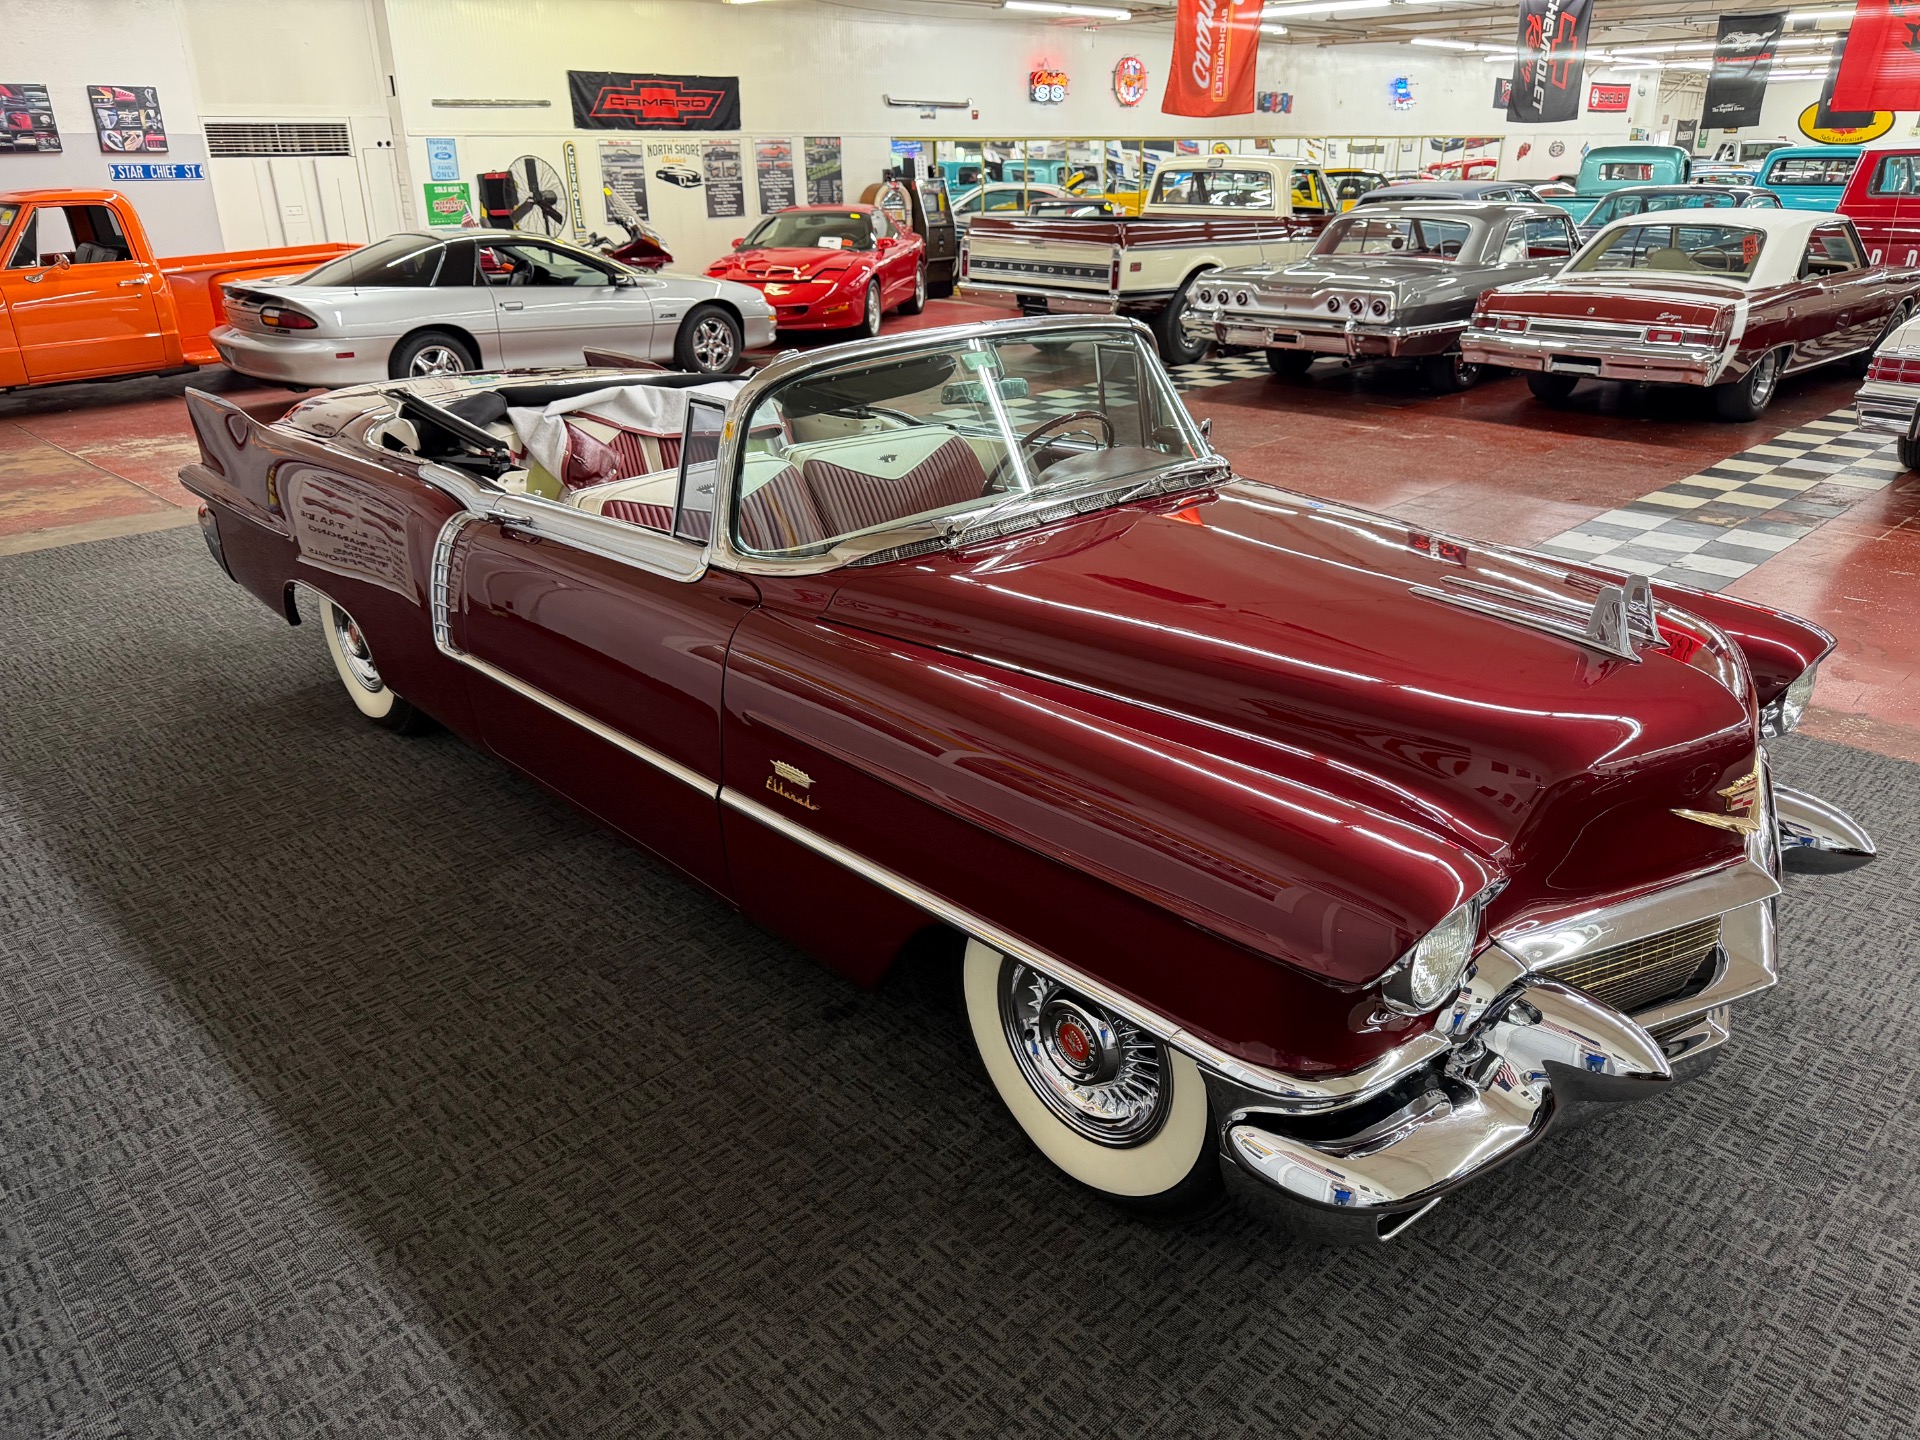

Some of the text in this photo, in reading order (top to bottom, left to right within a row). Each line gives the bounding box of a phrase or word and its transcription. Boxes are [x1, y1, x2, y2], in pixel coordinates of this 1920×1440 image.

[1192, 0, 1217, 89] maro
[1531, 0, 1560, 115] HEVROLET
[1215, 23, 1228, 96] CHEVROLET
[610, 97, 706, 108] CAMARO
[1034, 84, 1065, 102] SS
[1600, 92, 1628, 104] SHELBY
[647, 144, 701, 157] NORTH SHORE
[118, 165, 197, 179] STAR CHIEF ST
[567, 145, 583, 228] CHEVROLET
[981, 261, 1096, 276] CHEVROLET
[766, 776, 821, 811] Eldorado
[1067, 1015, 1096, 1062] ELDORADO
